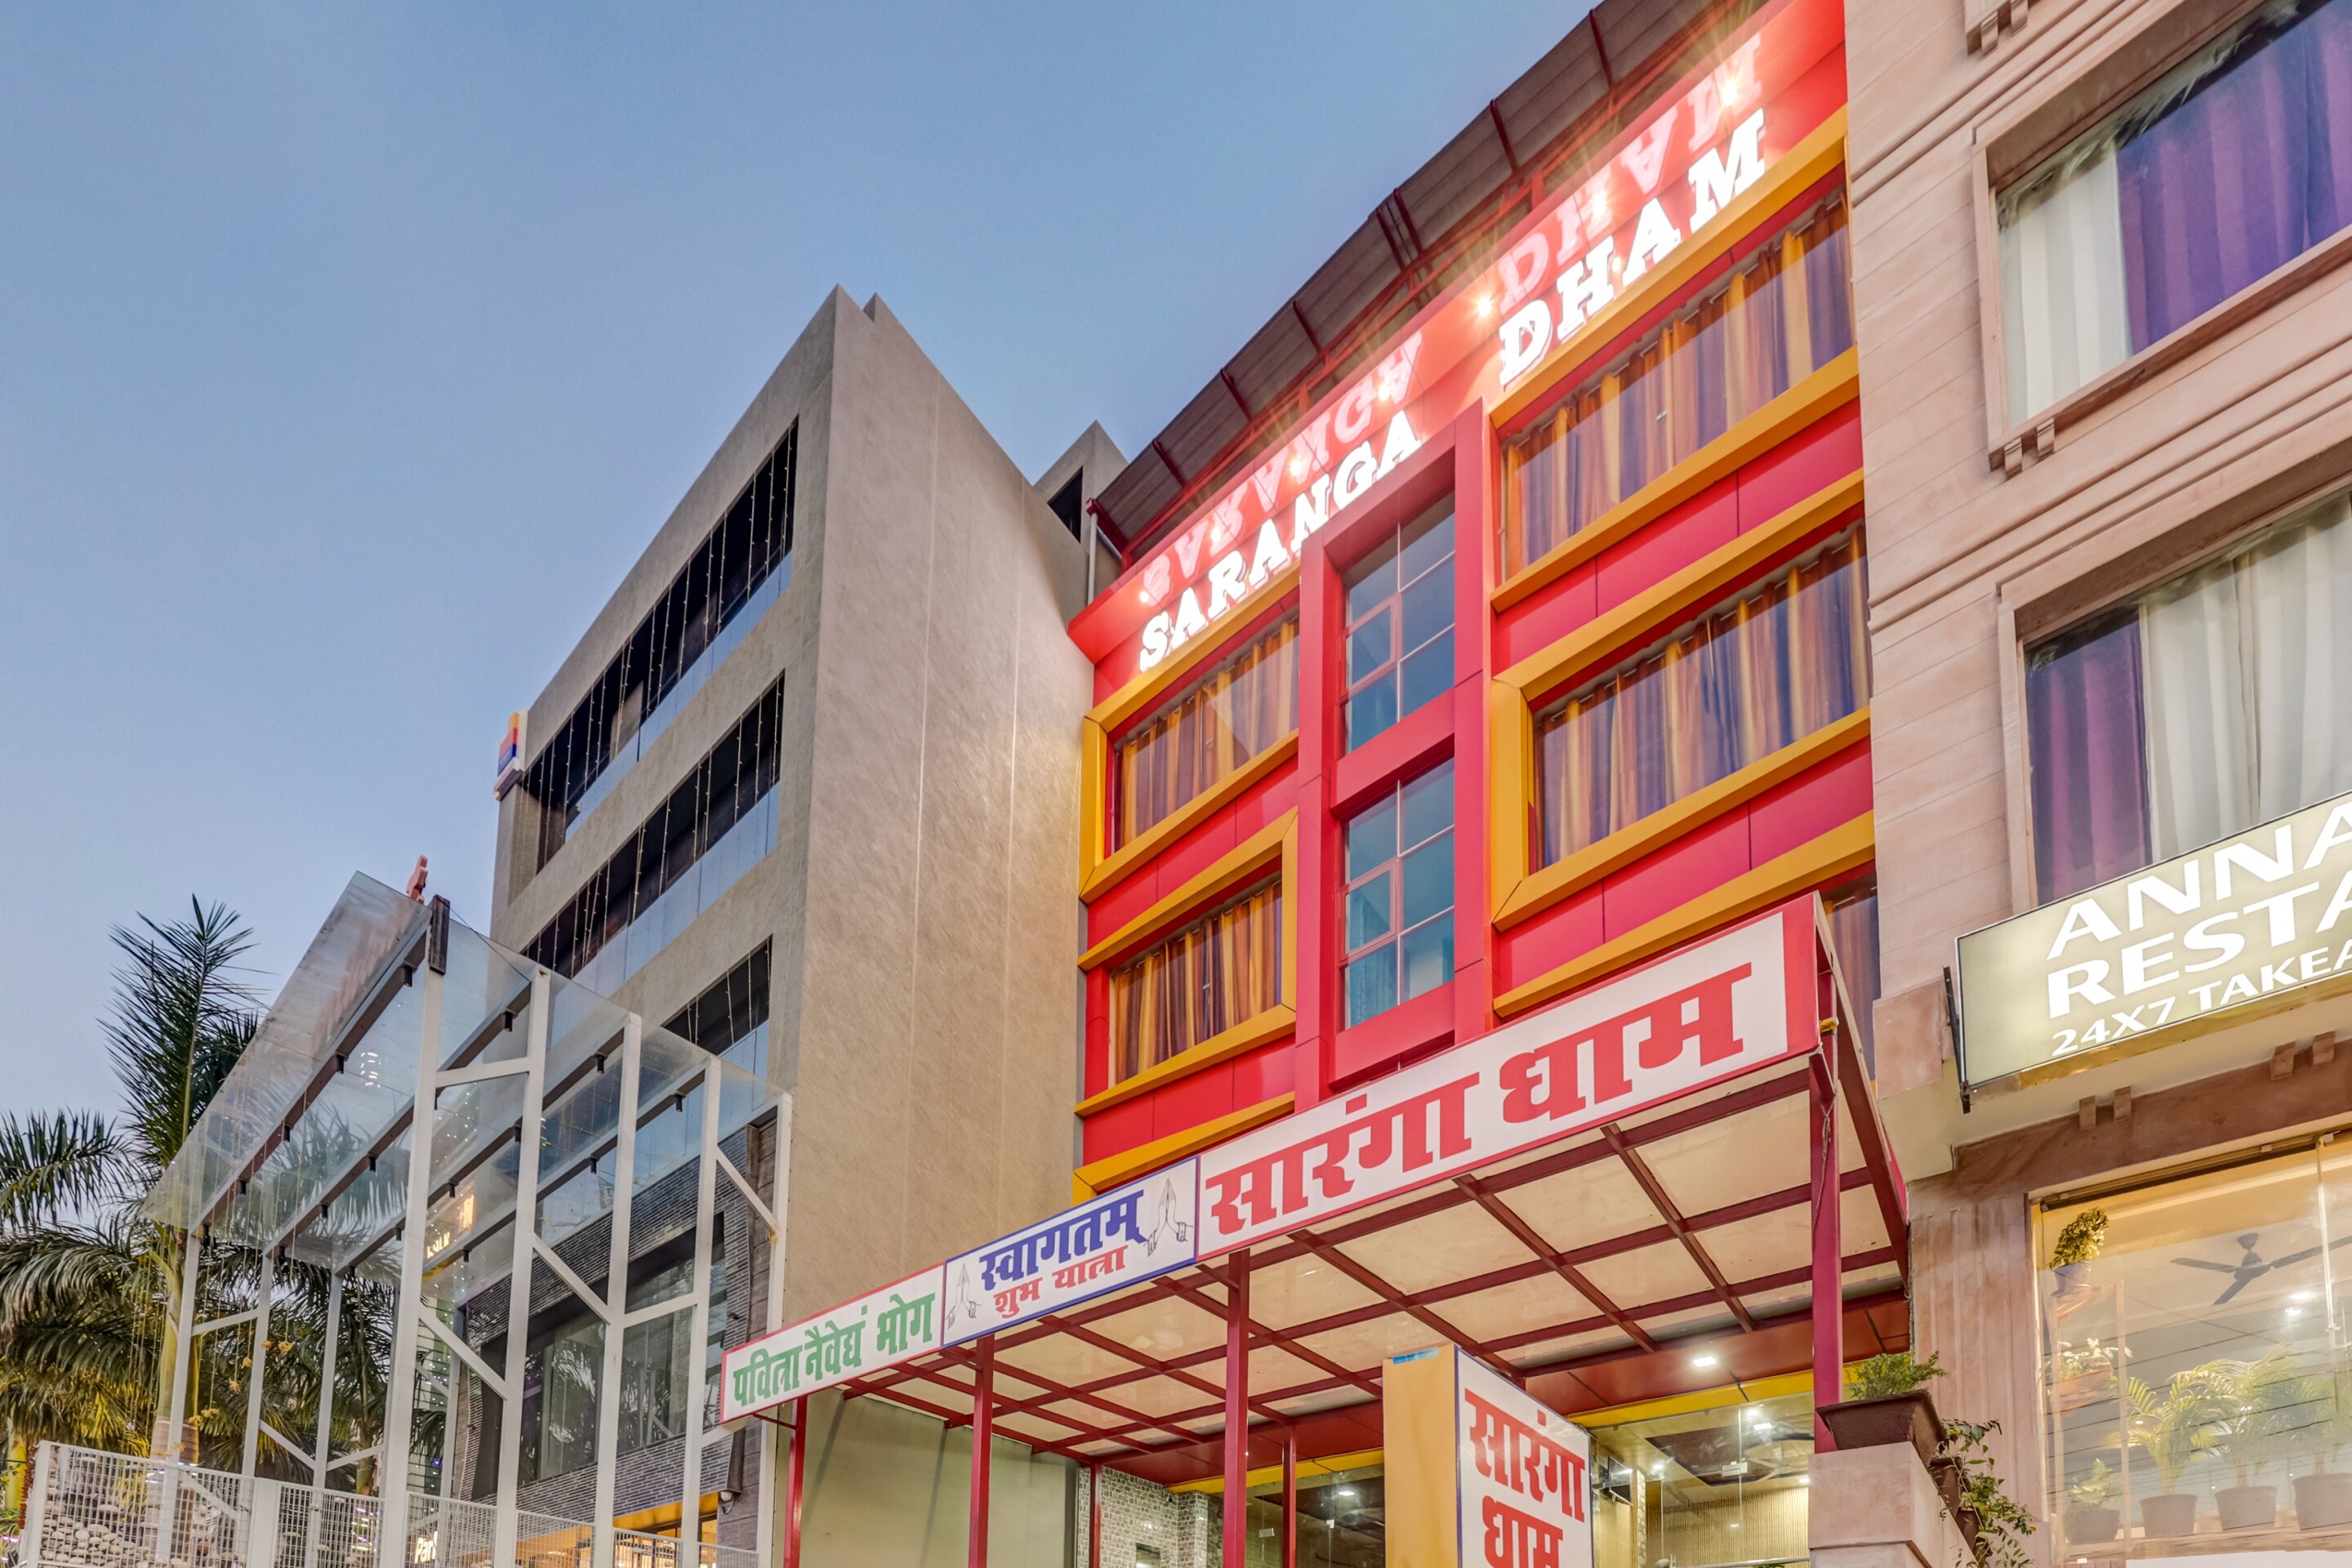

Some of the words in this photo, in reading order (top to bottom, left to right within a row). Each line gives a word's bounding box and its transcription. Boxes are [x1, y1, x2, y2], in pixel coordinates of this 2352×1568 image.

[1139, 410, 1422, 673] SARANGA
[1499, 108, 1766, 388] DHAM
[2047, 800, 2352, 960] ANNA
[2051, 996, 2176, 1057] 24X7
[1205, 1071, 1480, 1236] सारंगा
[1499, 961, 1753, 1123] धाम
[979, 1189, 1148, 1291] स्वागतम्
[876, 1293, 936, 1355] भोग
[993, 1276, 1043, 1319] शुभ
[1464, 1388, 1585, 1523] सारंगा
[1482, 1495, 1563, 1568] धाम
